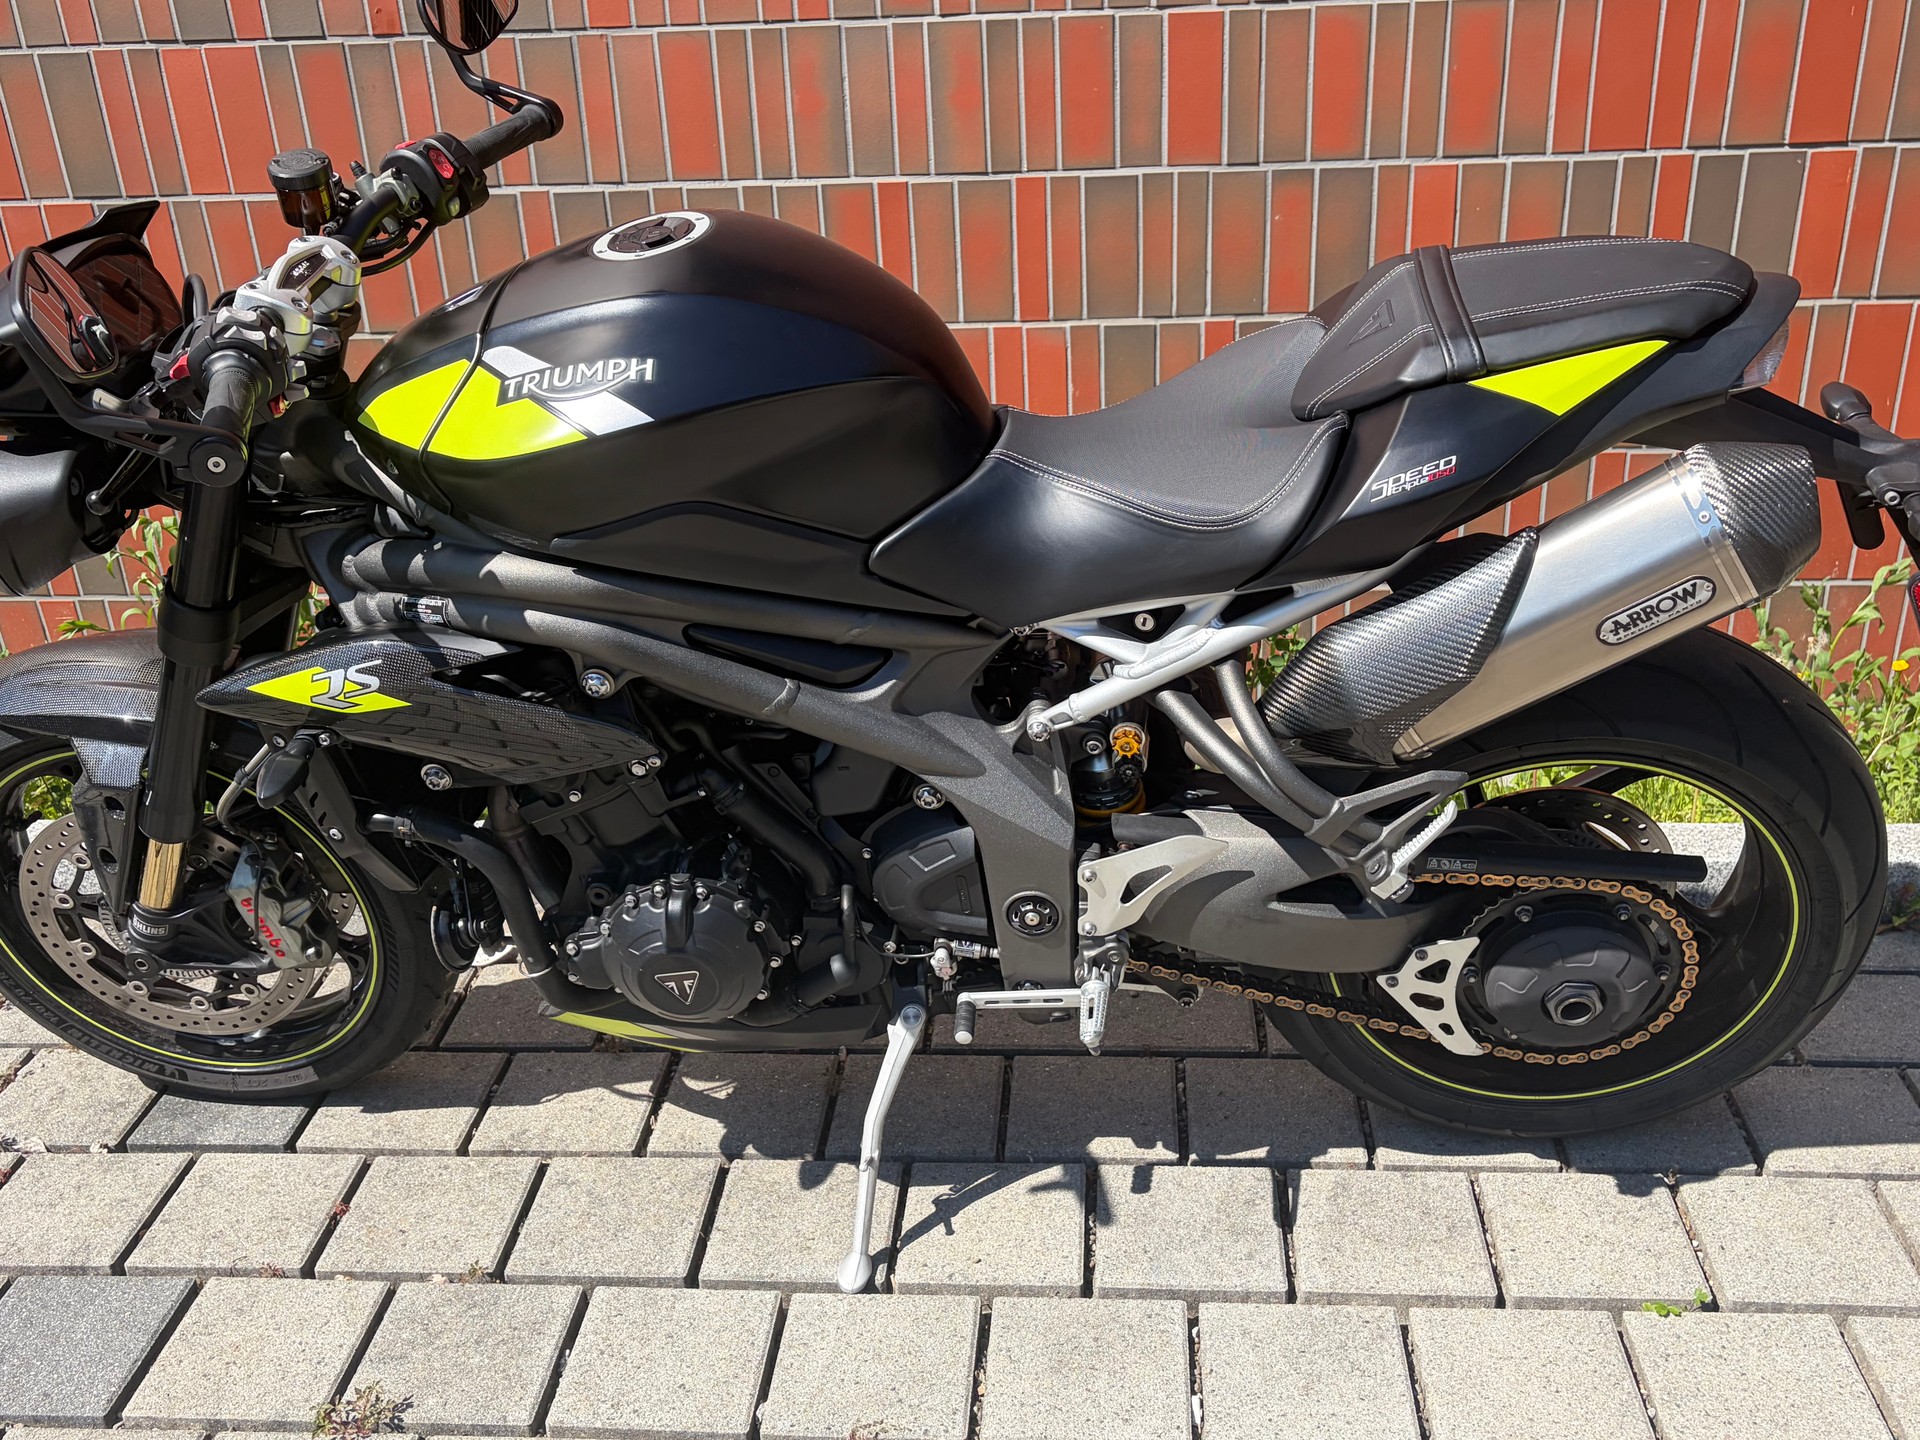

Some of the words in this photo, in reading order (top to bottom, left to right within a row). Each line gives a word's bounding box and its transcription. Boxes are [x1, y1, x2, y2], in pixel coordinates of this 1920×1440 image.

[505, 358, 654, 398] TRIUMPH
[1370, 455, 1457, 503] SPEED
[1609, 582, 1698, 636] ARROW
[67, 1027, 160, 1073] MICHELIN
